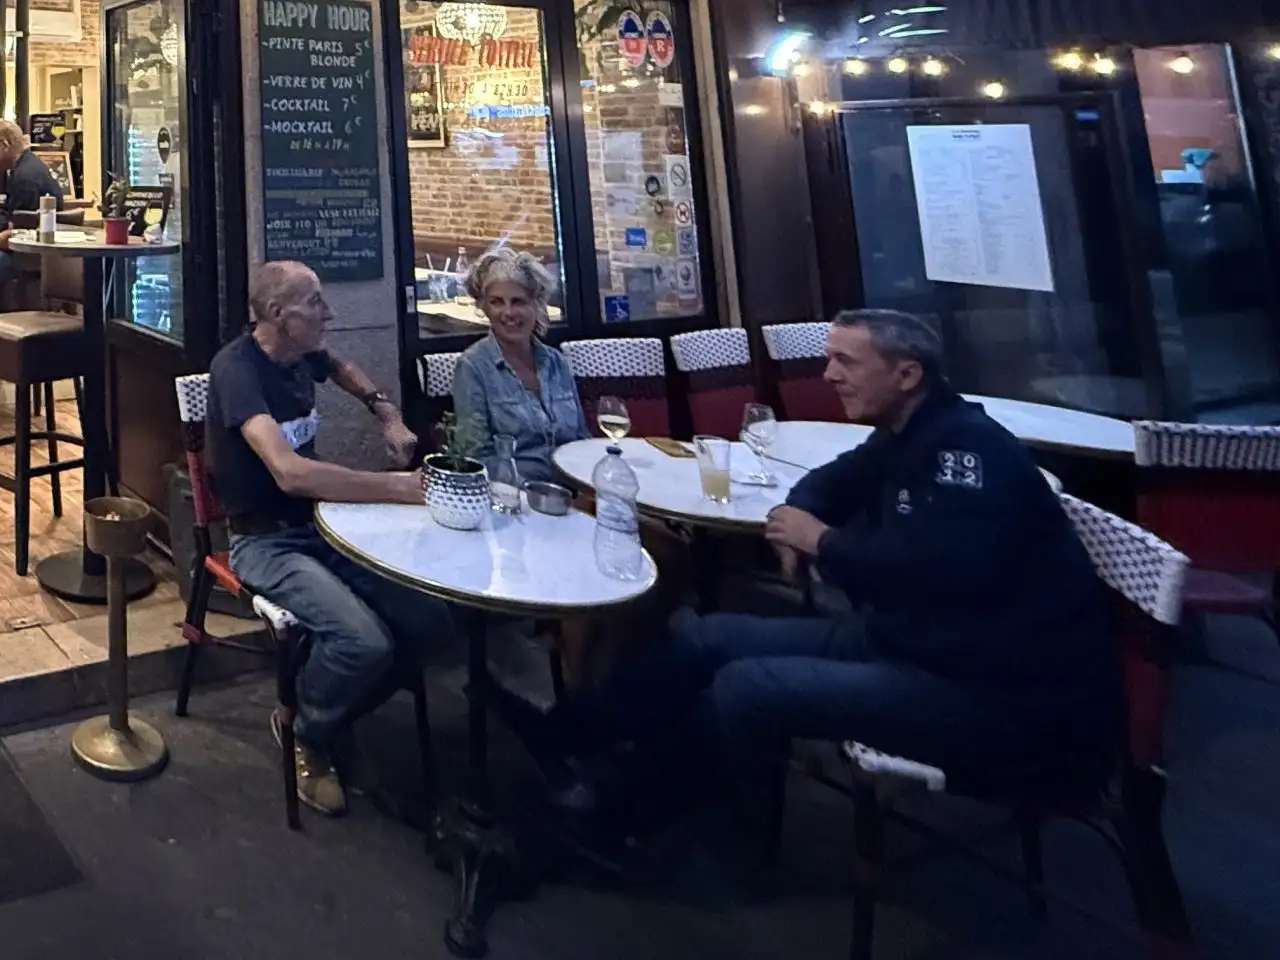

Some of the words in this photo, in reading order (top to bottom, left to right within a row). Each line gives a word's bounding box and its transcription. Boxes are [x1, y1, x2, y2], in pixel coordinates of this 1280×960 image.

[263, 0, 318, 28] HAPPY
[327, 5, 370, 31] HOUR
[308, 39, 343, 53] PARIS
[310, 54, 357, 67] BLONDE
[311, 77, 326, 89] DE
[331, 77, 353, 89] VIN
